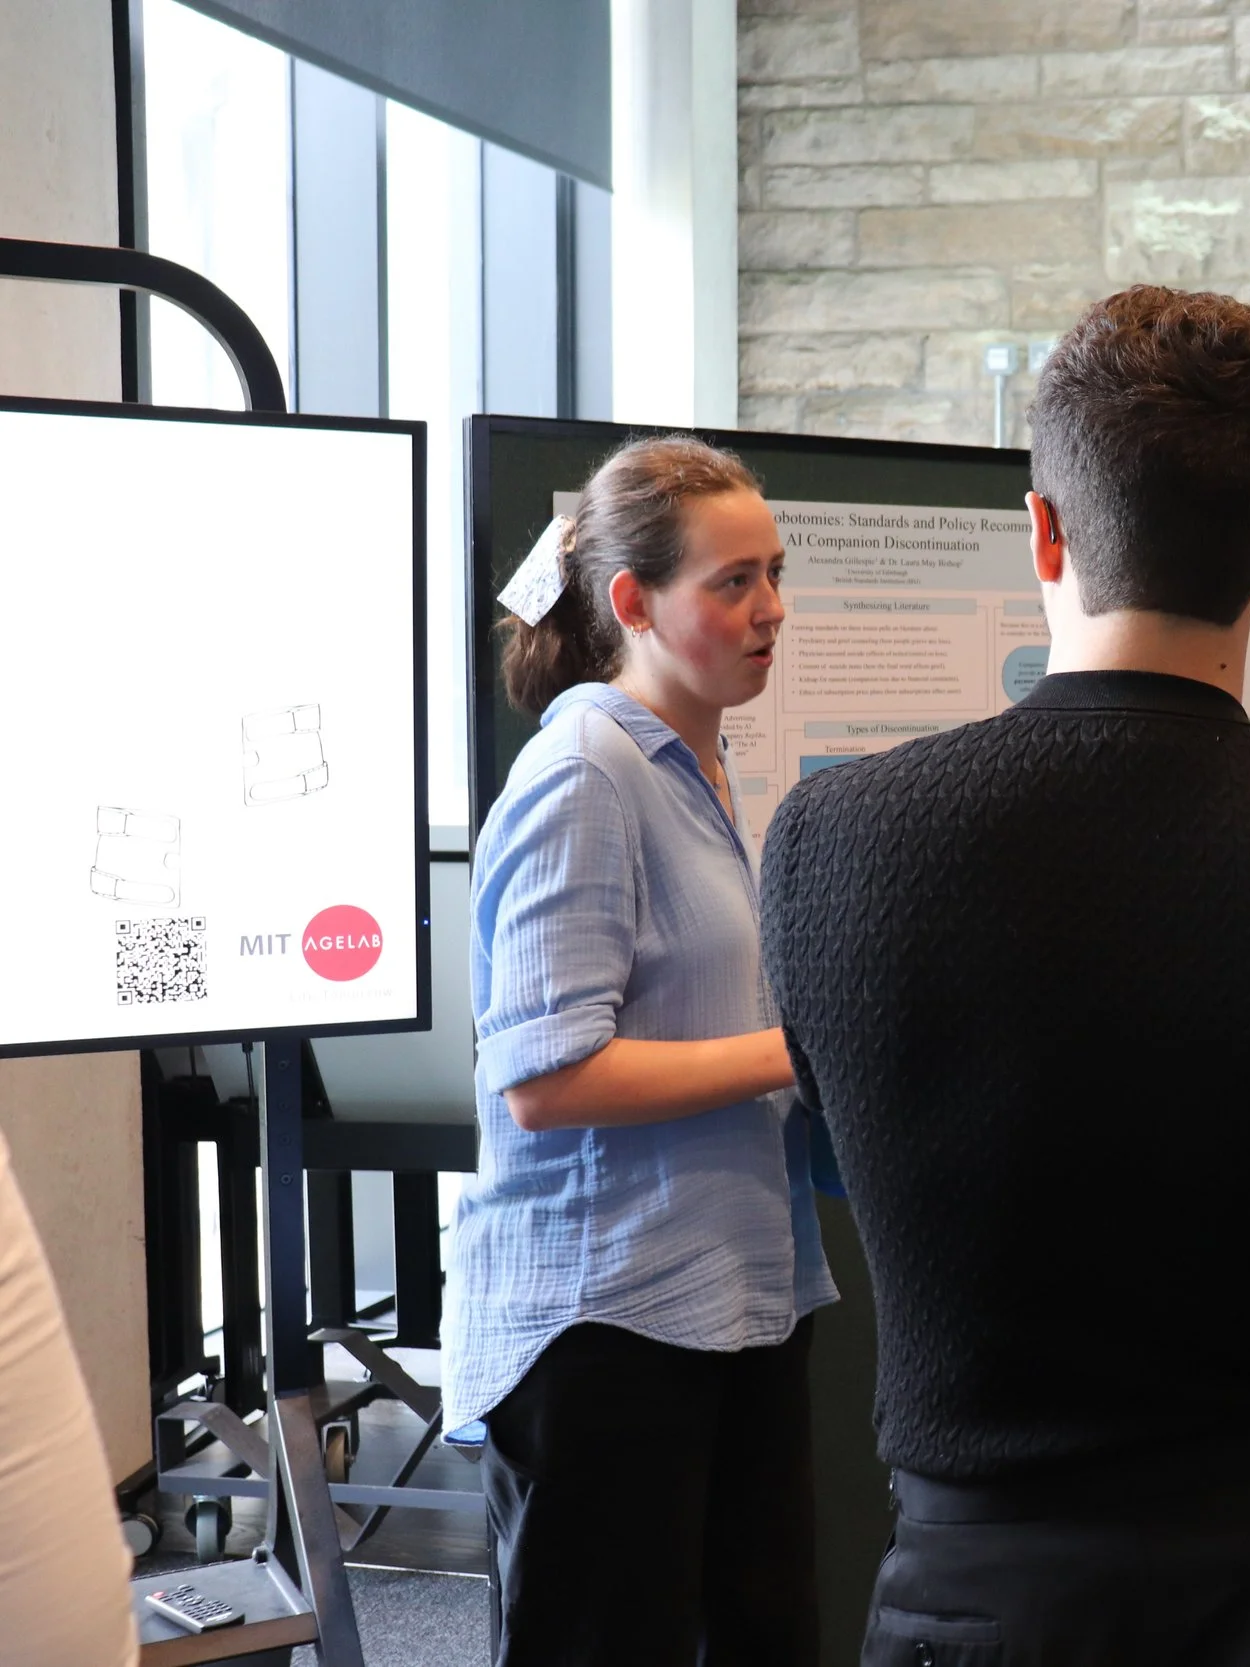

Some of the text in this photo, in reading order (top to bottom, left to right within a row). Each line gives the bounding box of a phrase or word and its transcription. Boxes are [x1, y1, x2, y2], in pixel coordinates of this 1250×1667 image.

[774, 511, 1032, 534] obotomies: Standards and Policy Recomm
[786, 533, 979, 552] AI Companion Discontinuation
[808, 556, 843, 565] Alexandra
[843, 601, 930, 612] Synthesizing Literature
[846, 723, 939, 735] Types of Discontinuation
[825, 745, 866, 753] Termination
[240, 934, 381, 956] MIT AGELAB
